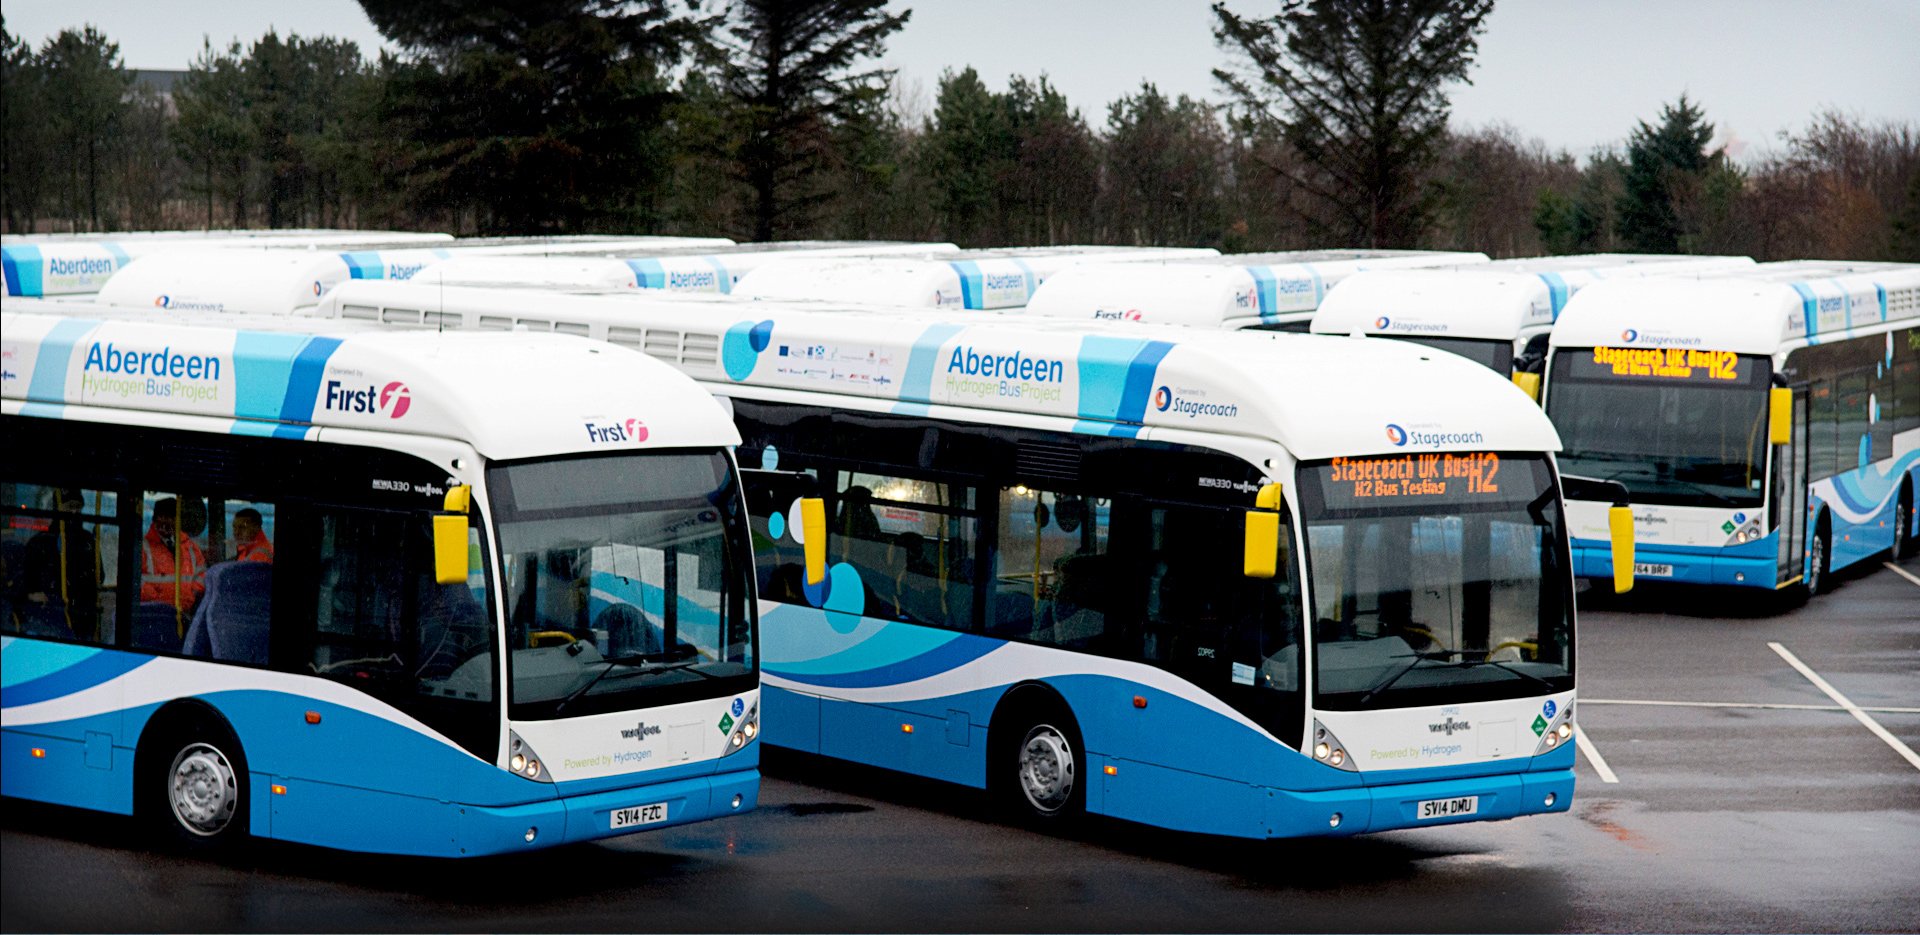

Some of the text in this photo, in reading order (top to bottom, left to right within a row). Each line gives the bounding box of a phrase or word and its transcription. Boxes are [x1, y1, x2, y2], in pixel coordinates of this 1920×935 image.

[49, 257, 112, 275] Aberdeen
[390, 263, 424, 280] Aber
[670, 270, 714, 288] Aberdeen
[1095, 309, 1122, 320] First
[1640, 334, 1701, 345] Stagecoach
[84, 342, 220, 381] Aberdeen
[947, 345, 1063, 383] Aberdeen
[1709, 350, 1738, 379] H2
[82, 373, 218, 403] HydrogenBusProject
[326, 380, 376, 413] First
[946, 376, 1061, 402] HydrogenBusProject
[1173, 397, 1238, 418] Stagecoach
[585, 423, 627, 442] First
[1411, 431, 1483, 448] Stagecoach
[1332, 453, 1470, 481] Stagecoach UK Bus
[1467, 451, 1499, 493] H2
[1354, 478, 1446, 497] H2 Bus Testing
[564, 750, 652, 769] Powered by Hydrogen
[1370, 744, 1462, 760] Powered by Hydrogen
[616, 805, 662, 826] SV14 FZC
[1424, 797, 1473, 816] SV14 DMU
